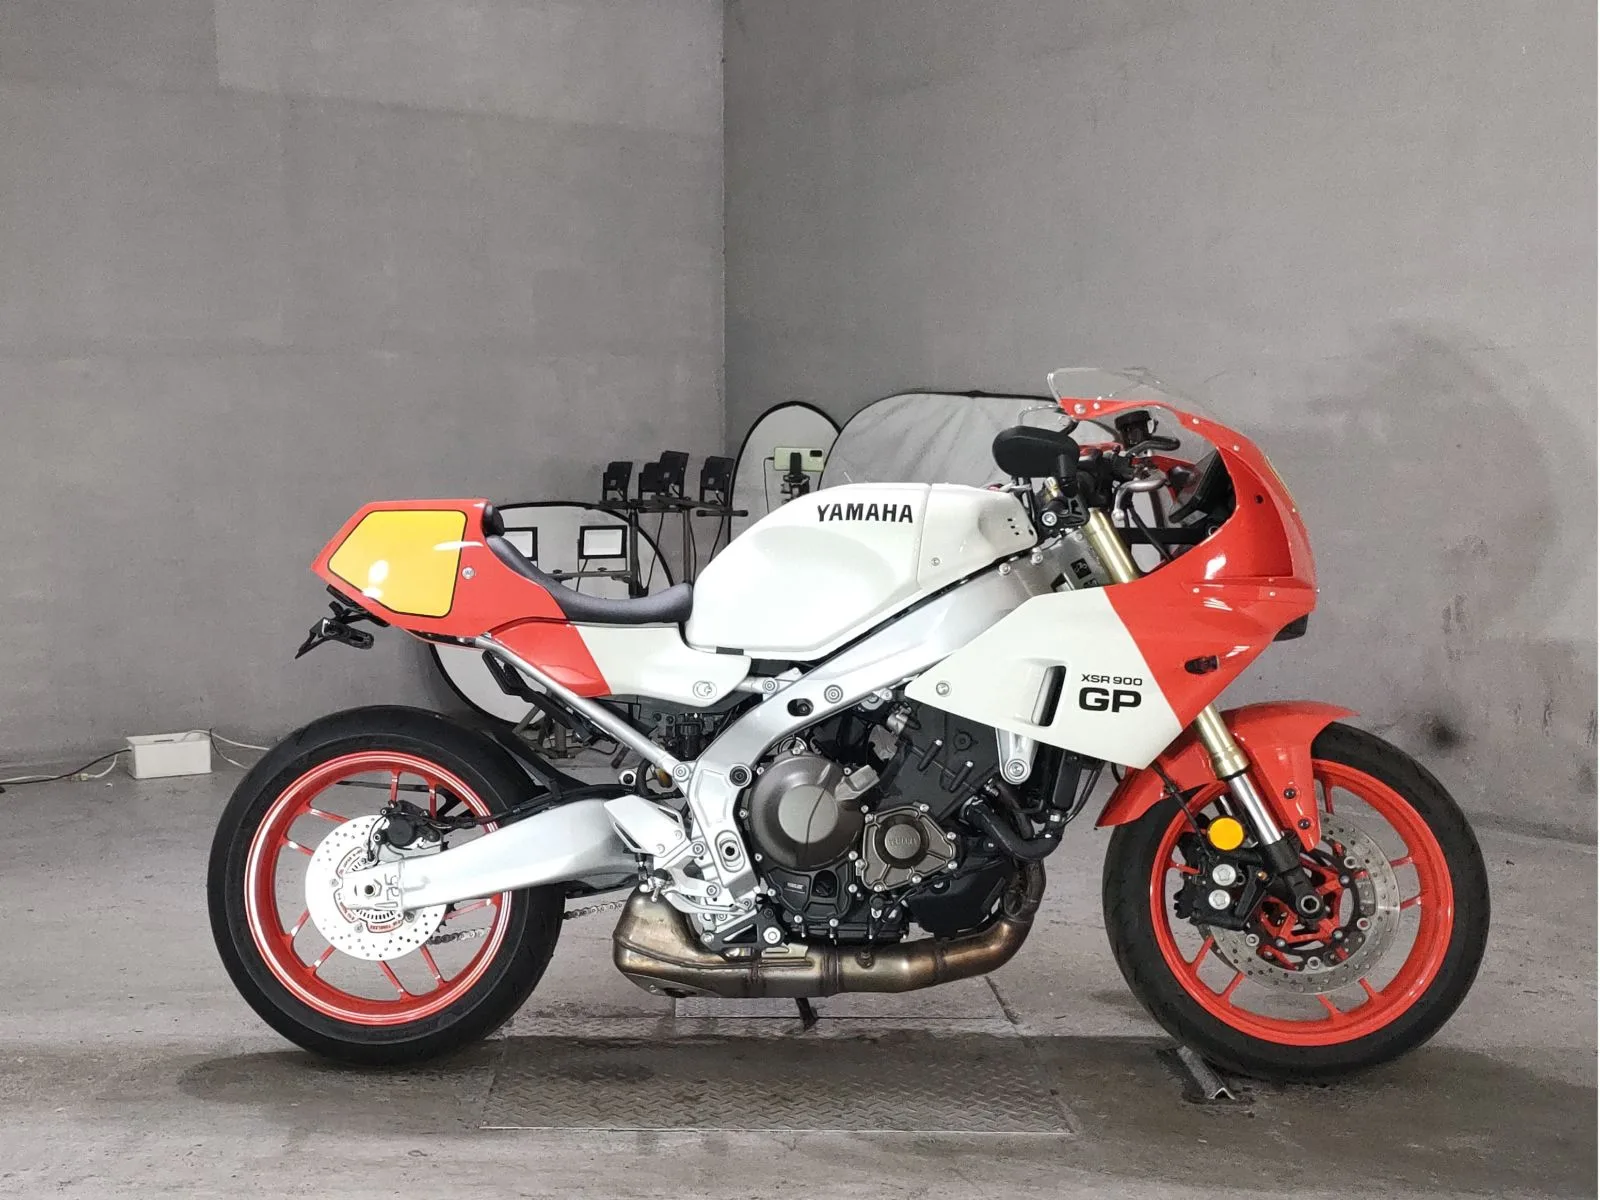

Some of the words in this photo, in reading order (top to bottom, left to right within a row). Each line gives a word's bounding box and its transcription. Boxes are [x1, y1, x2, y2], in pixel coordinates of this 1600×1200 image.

[817, 503, 913, 523] YAMAHA
[1081, 674, 1110, 684] XSR
[1113, 676, 1143, 686] 900
[1079, 687, 1142, 713] GP
